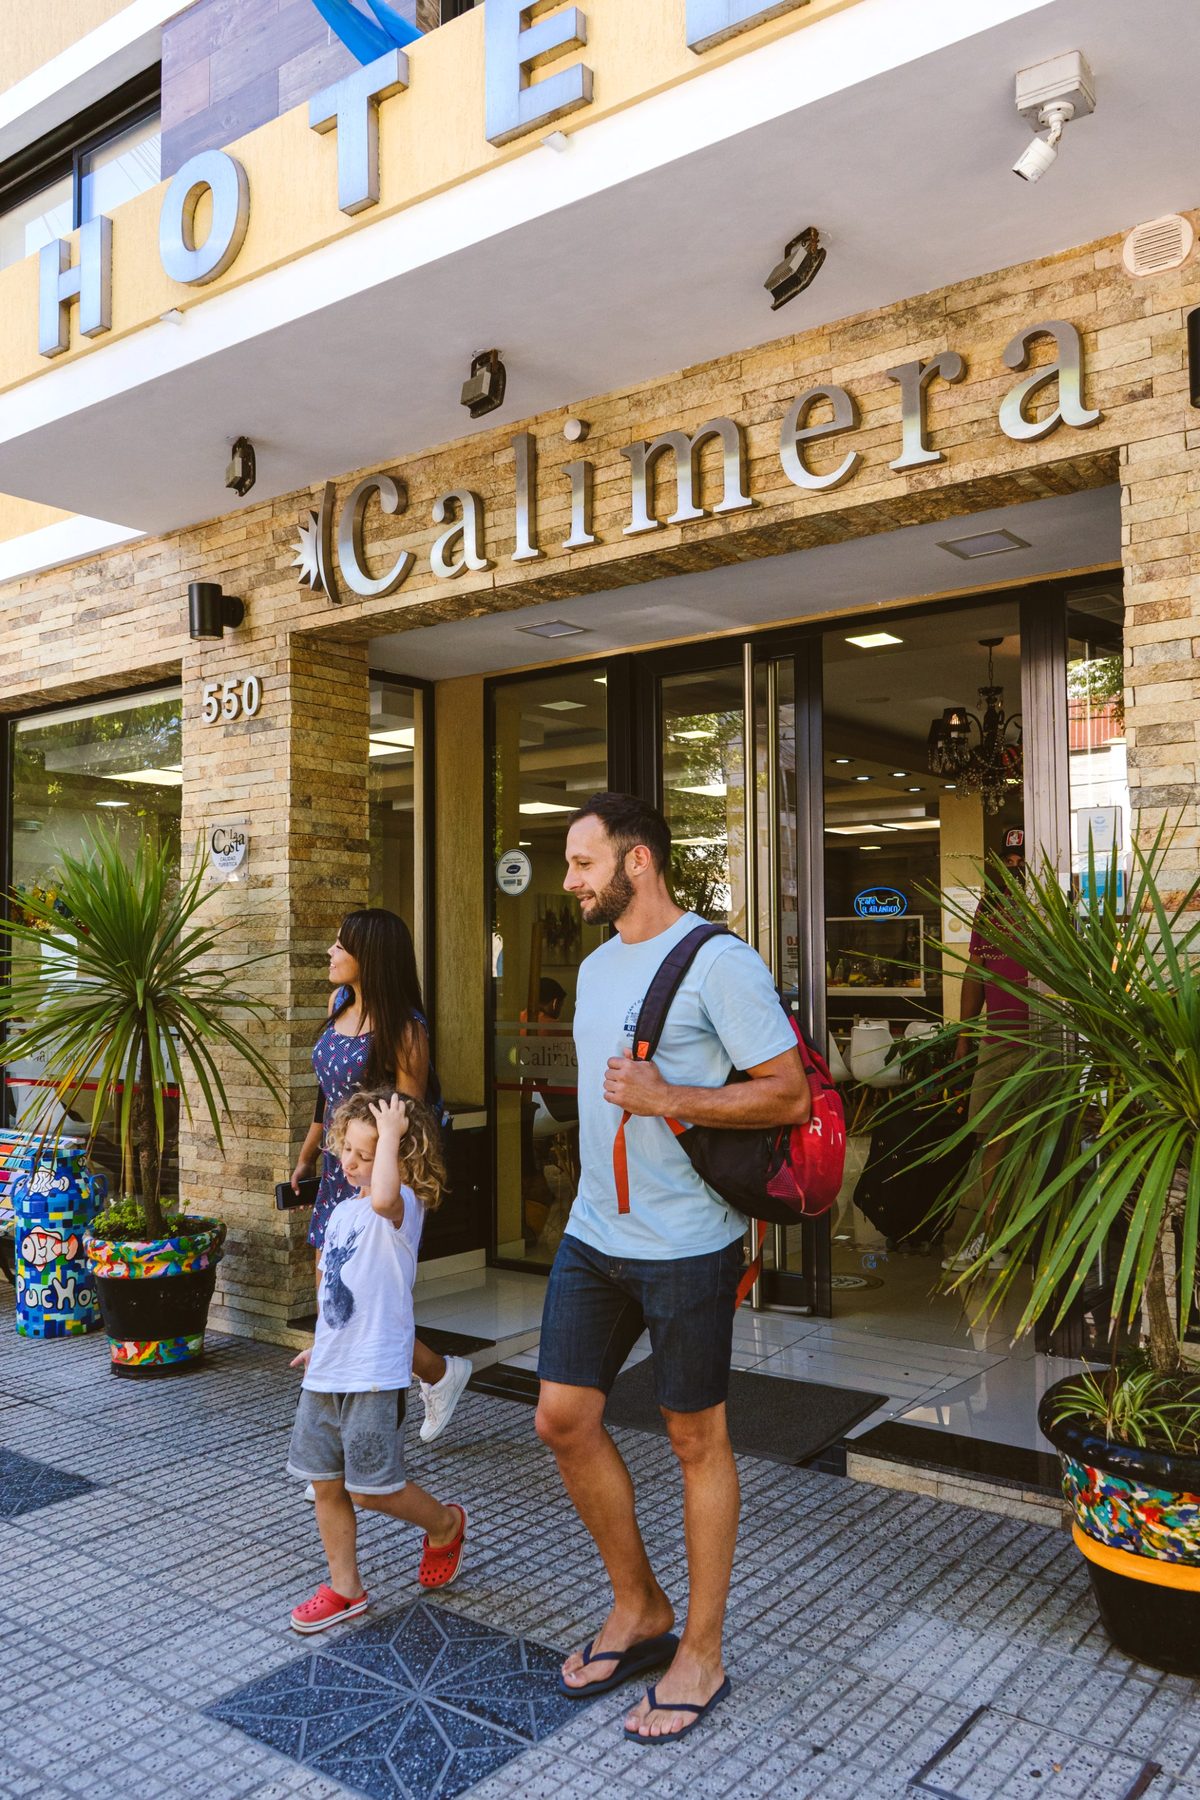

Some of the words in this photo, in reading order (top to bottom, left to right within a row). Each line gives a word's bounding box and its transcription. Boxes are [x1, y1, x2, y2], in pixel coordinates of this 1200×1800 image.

[39, 0, 811, 359] HOTE
[338, 319, 1104, 597] Calimera
[202, 676, 261, 723] 550
[212, 829, 245, 855] Costa
[518, 1046, 578, 1067] Calime
